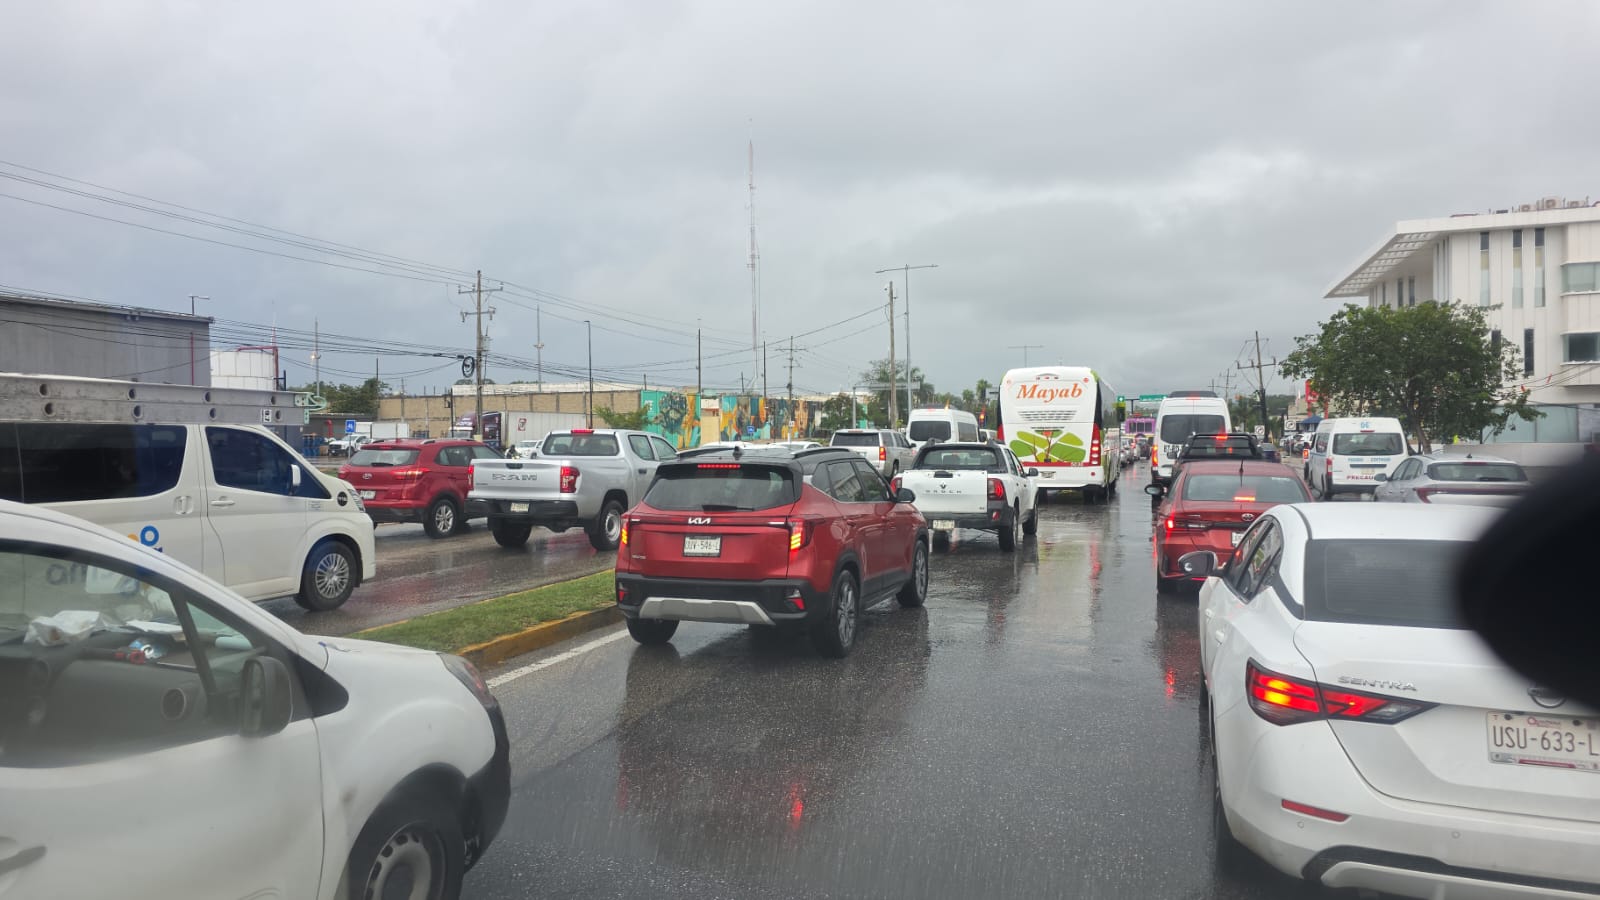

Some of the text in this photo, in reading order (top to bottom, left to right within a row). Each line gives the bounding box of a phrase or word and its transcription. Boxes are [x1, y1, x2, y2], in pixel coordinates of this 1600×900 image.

[1016, 383, 1083, 403] Mayab
[1337, 676, 1417, 691] SENTRA
[1492, 725, 1600, 756] USU-633-L
